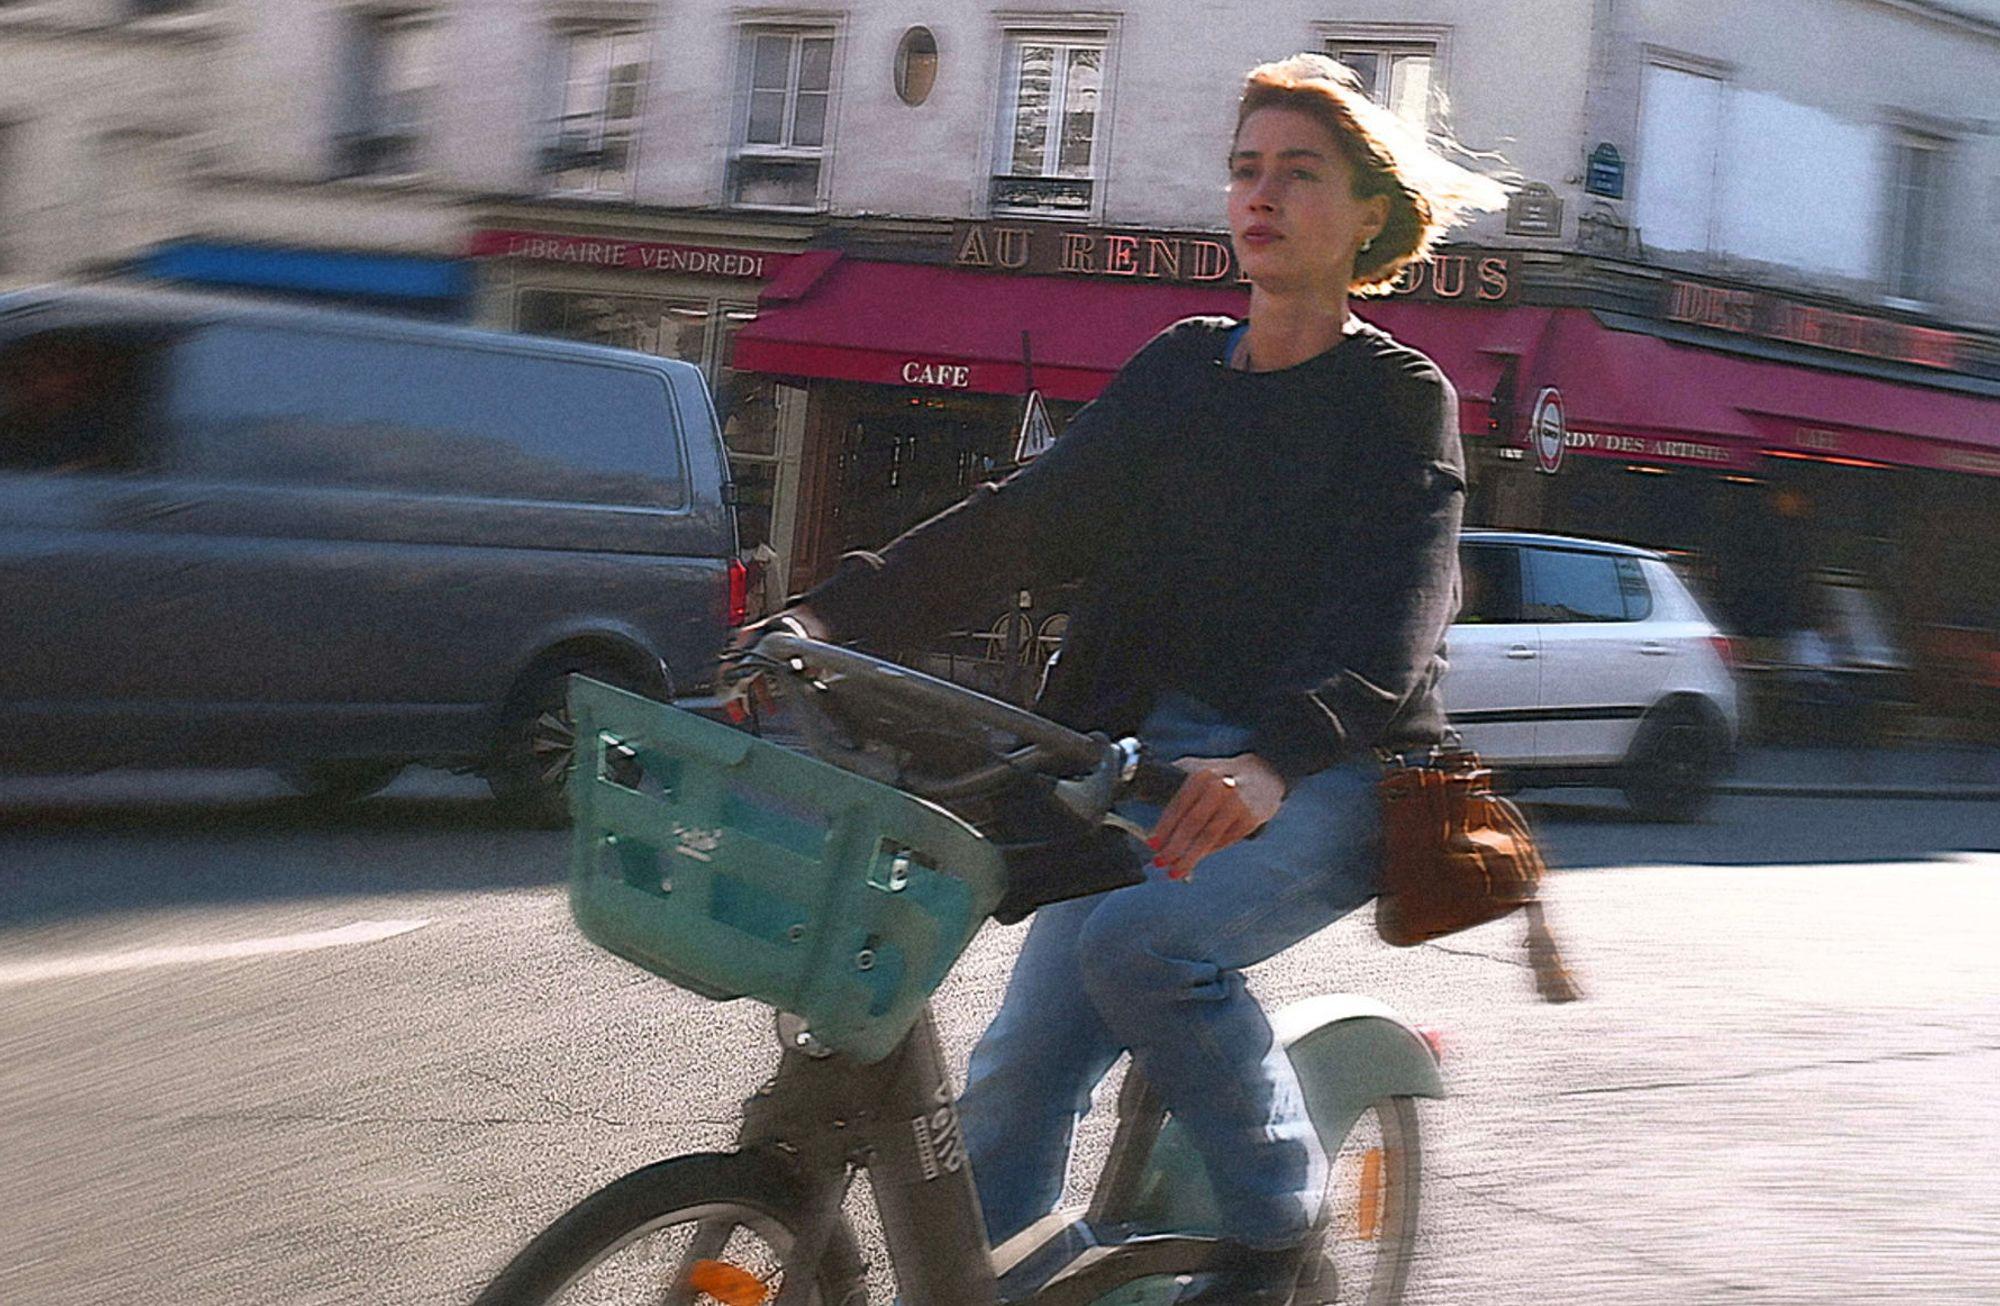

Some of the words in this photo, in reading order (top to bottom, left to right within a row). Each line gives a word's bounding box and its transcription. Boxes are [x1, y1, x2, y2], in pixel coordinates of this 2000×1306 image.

[507, 236, 625, 265] LIBRAIRIE
[640, 247, 763, 277] VENDREDI
[956, 224, 1034, 268] AU
[1058, 233, 1252, 283] REND
[1395, 253, 1509, 300] OUS
[902, 361, 970, 388] CAFE
[1605, 434, 1645, 453] DES
